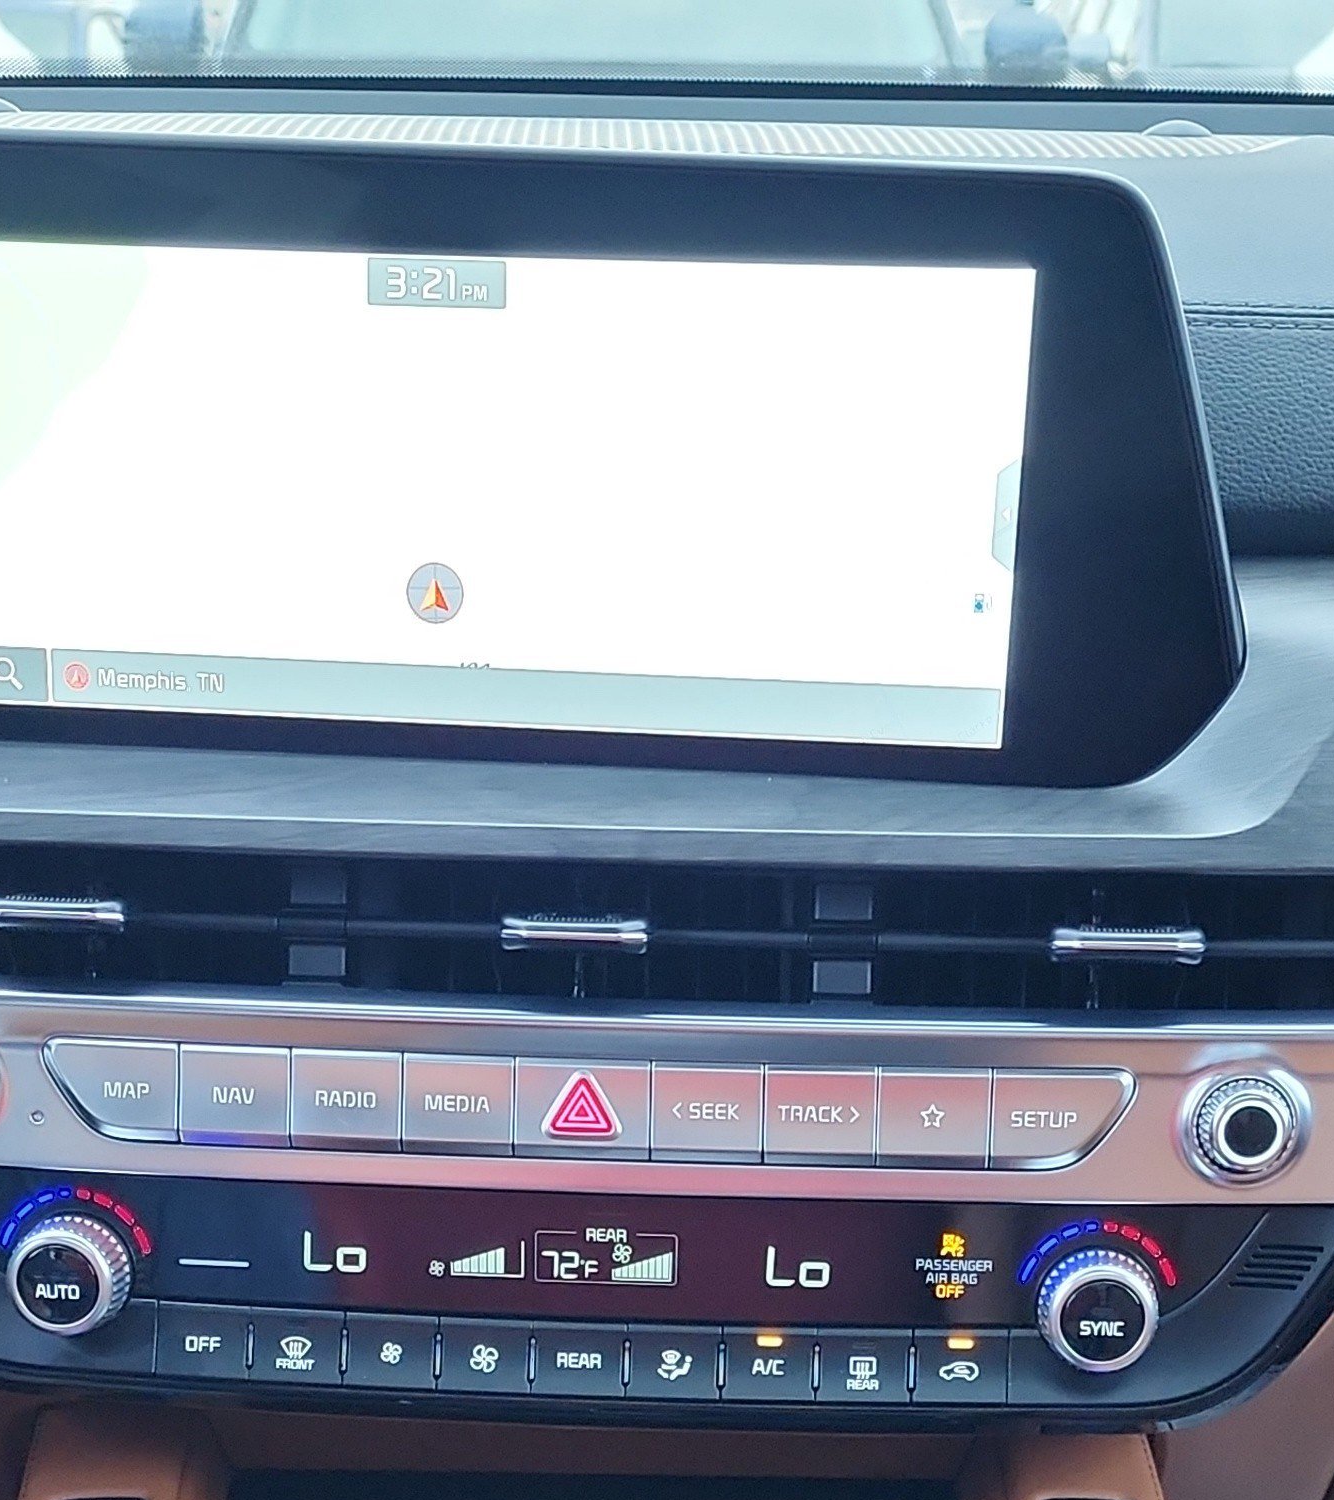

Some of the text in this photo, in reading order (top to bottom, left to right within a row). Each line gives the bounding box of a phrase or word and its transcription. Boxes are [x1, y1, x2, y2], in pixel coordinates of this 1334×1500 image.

[386, 265, 488, 302] 3:21 PM
[197, 672, 225, 693] TN
[103, 1081, 150, 1100] MAP
[212, 1086, 255, 1105] NAV
[315, 1089, 377, 1109] RADIO
[424, 1095, 490, 1114] MEDIA
[689, 1102, 740, 1121] SEEK
[778, 1105, 844, 1124] TRACK
[1011, 1111, 1078, 1129] SETUP
[586, 1228, 627, 1242] REAR
[303, 1230, 367, 1273] Lo
[765, 1245, 830, 1288] Lo
[915, 1258, 993, 1272] PASSENGER
[925, 1272, 978, 1285] AIR BAG
[35, 1284, 80, 1300] AUTO
[935, 1284, 965, 1299] OFF
[1079, 1321, 1125, 1338] SYNC
[185, 1335, 222, 1353] OFF
[275, 1357, 315, 1371] FRONT
[556, 1351, 603, 1370] REAR
[752, 1358, 785, 1376] A/C
[846, 1379, 879, 1391] REAR
